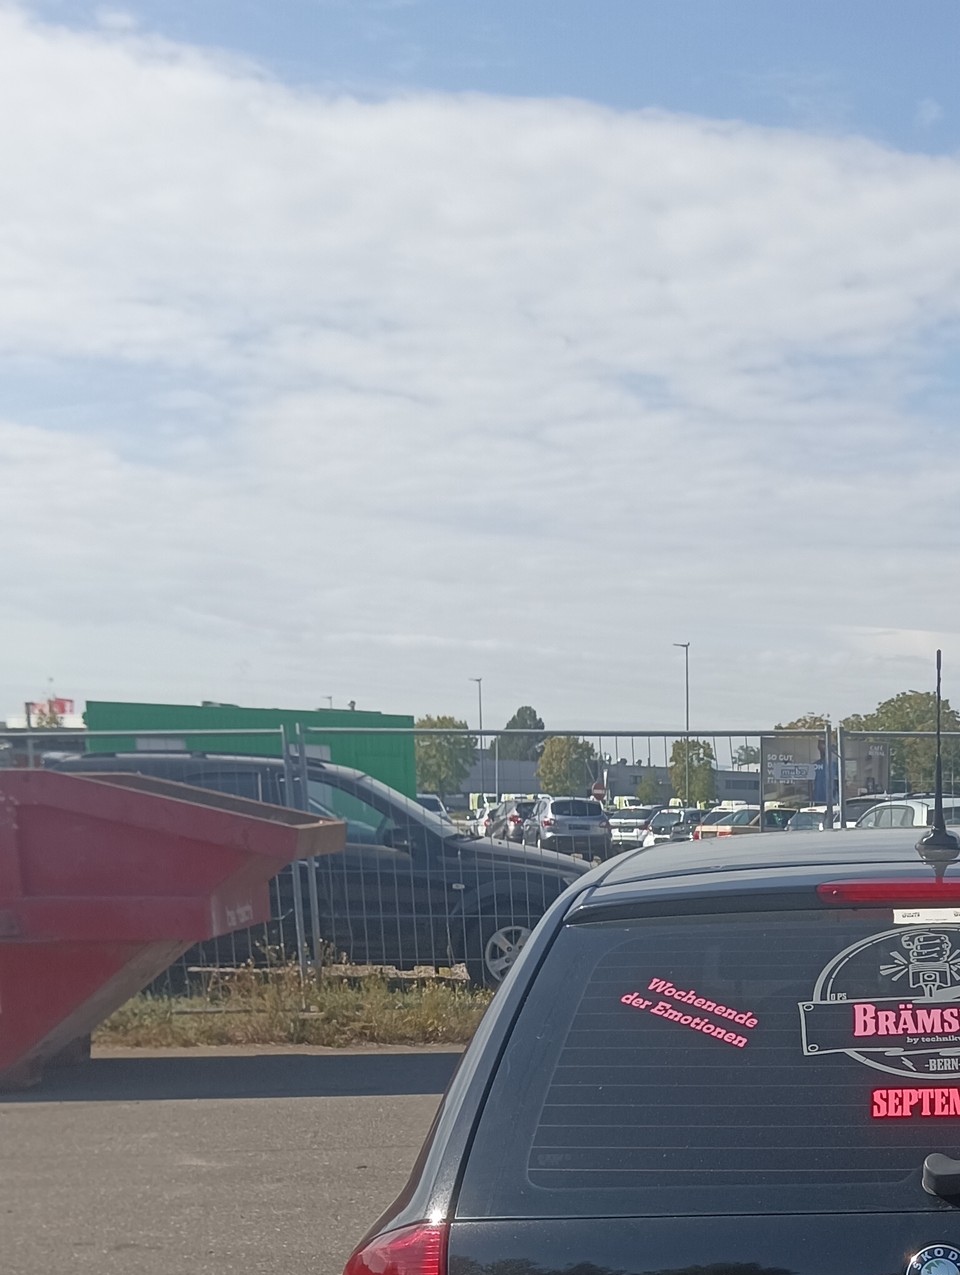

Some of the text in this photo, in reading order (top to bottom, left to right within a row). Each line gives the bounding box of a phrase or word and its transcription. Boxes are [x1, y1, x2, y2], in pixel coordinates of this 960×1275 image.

[648, 977, 759, 1028] Wochenende
[837, 992, 847, 1000] PS
[621, 992, 748, 1048] der Emotionen
[906, 1036, 920, 1044] by
